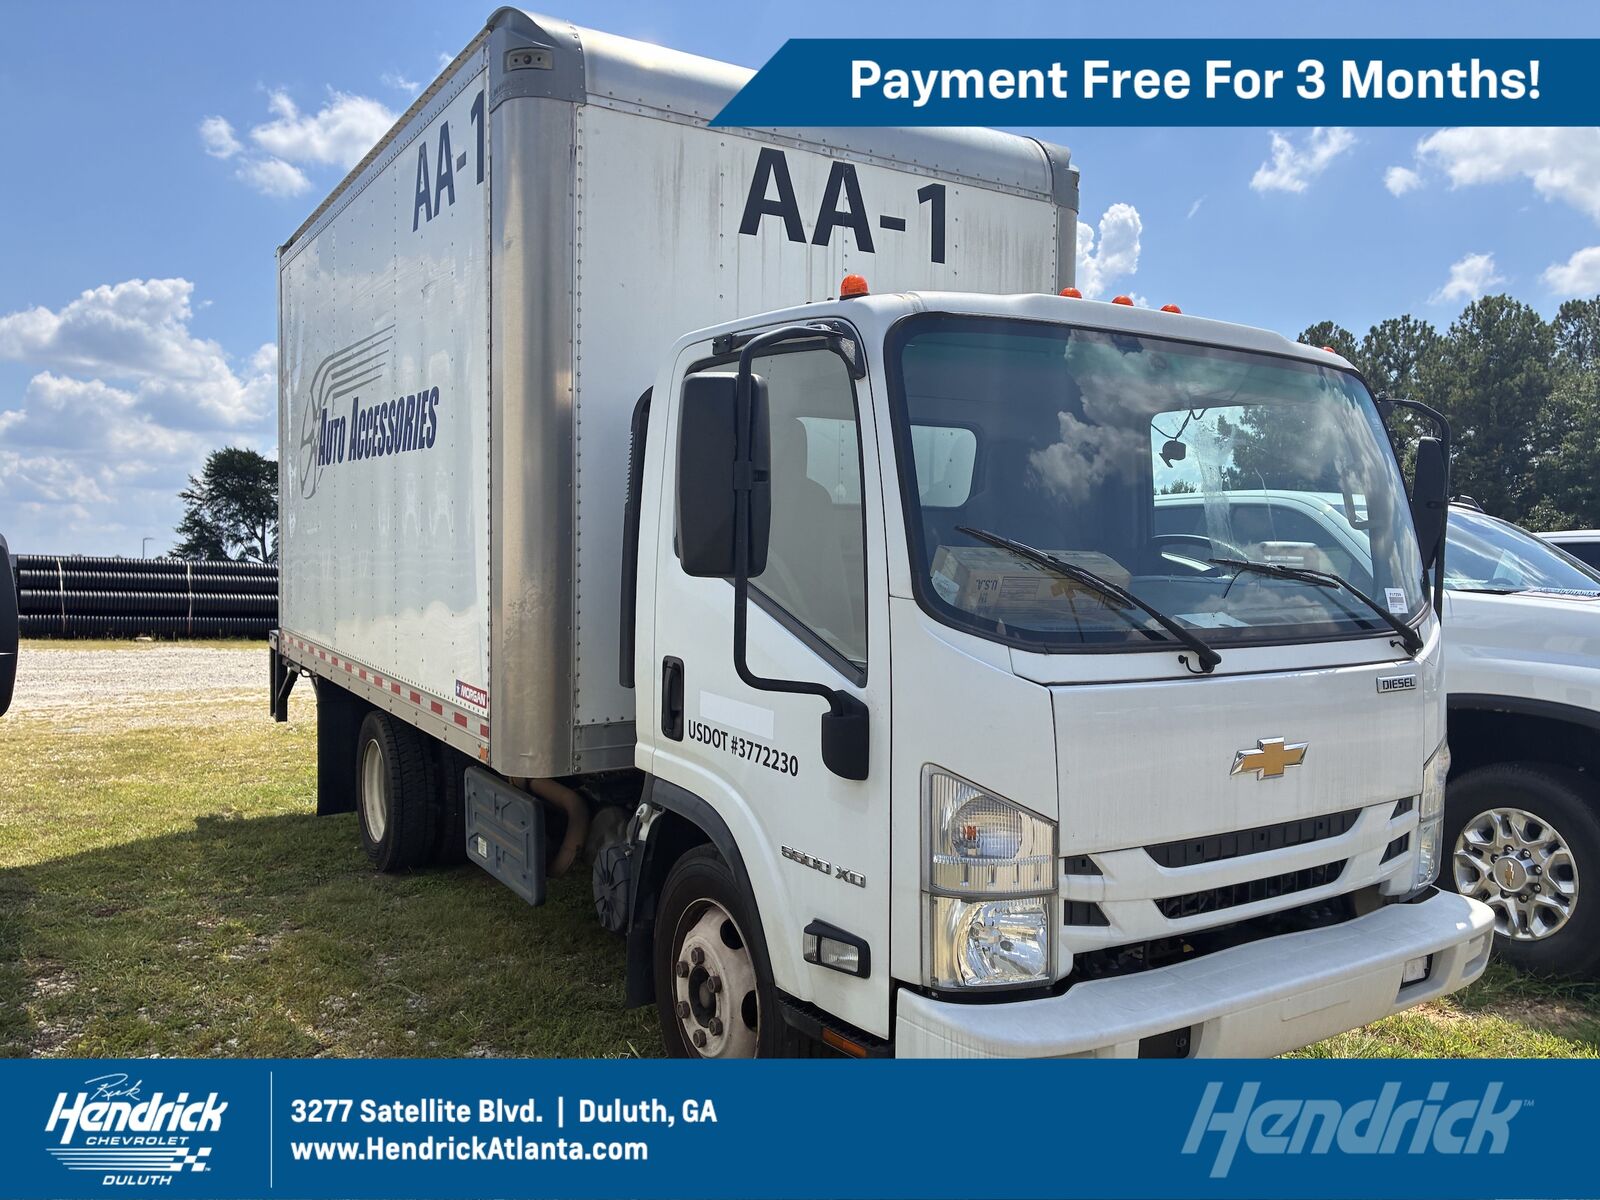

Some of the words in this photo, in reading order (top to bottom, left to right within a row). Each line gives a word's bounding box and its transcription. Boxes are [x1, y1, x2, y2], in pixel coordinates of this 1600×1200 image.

[412, 89, 485, 232] AA-1
[738, 146, 946, 265] AA-1
[460, 684, 487, 707] MORGAN
[1382, 677, 1416, 690] DIESEL
[688, 719, 728, 752] USDOT
[731, 736, 799, 777] #3772230
[835, 865, 866, 889] XD
